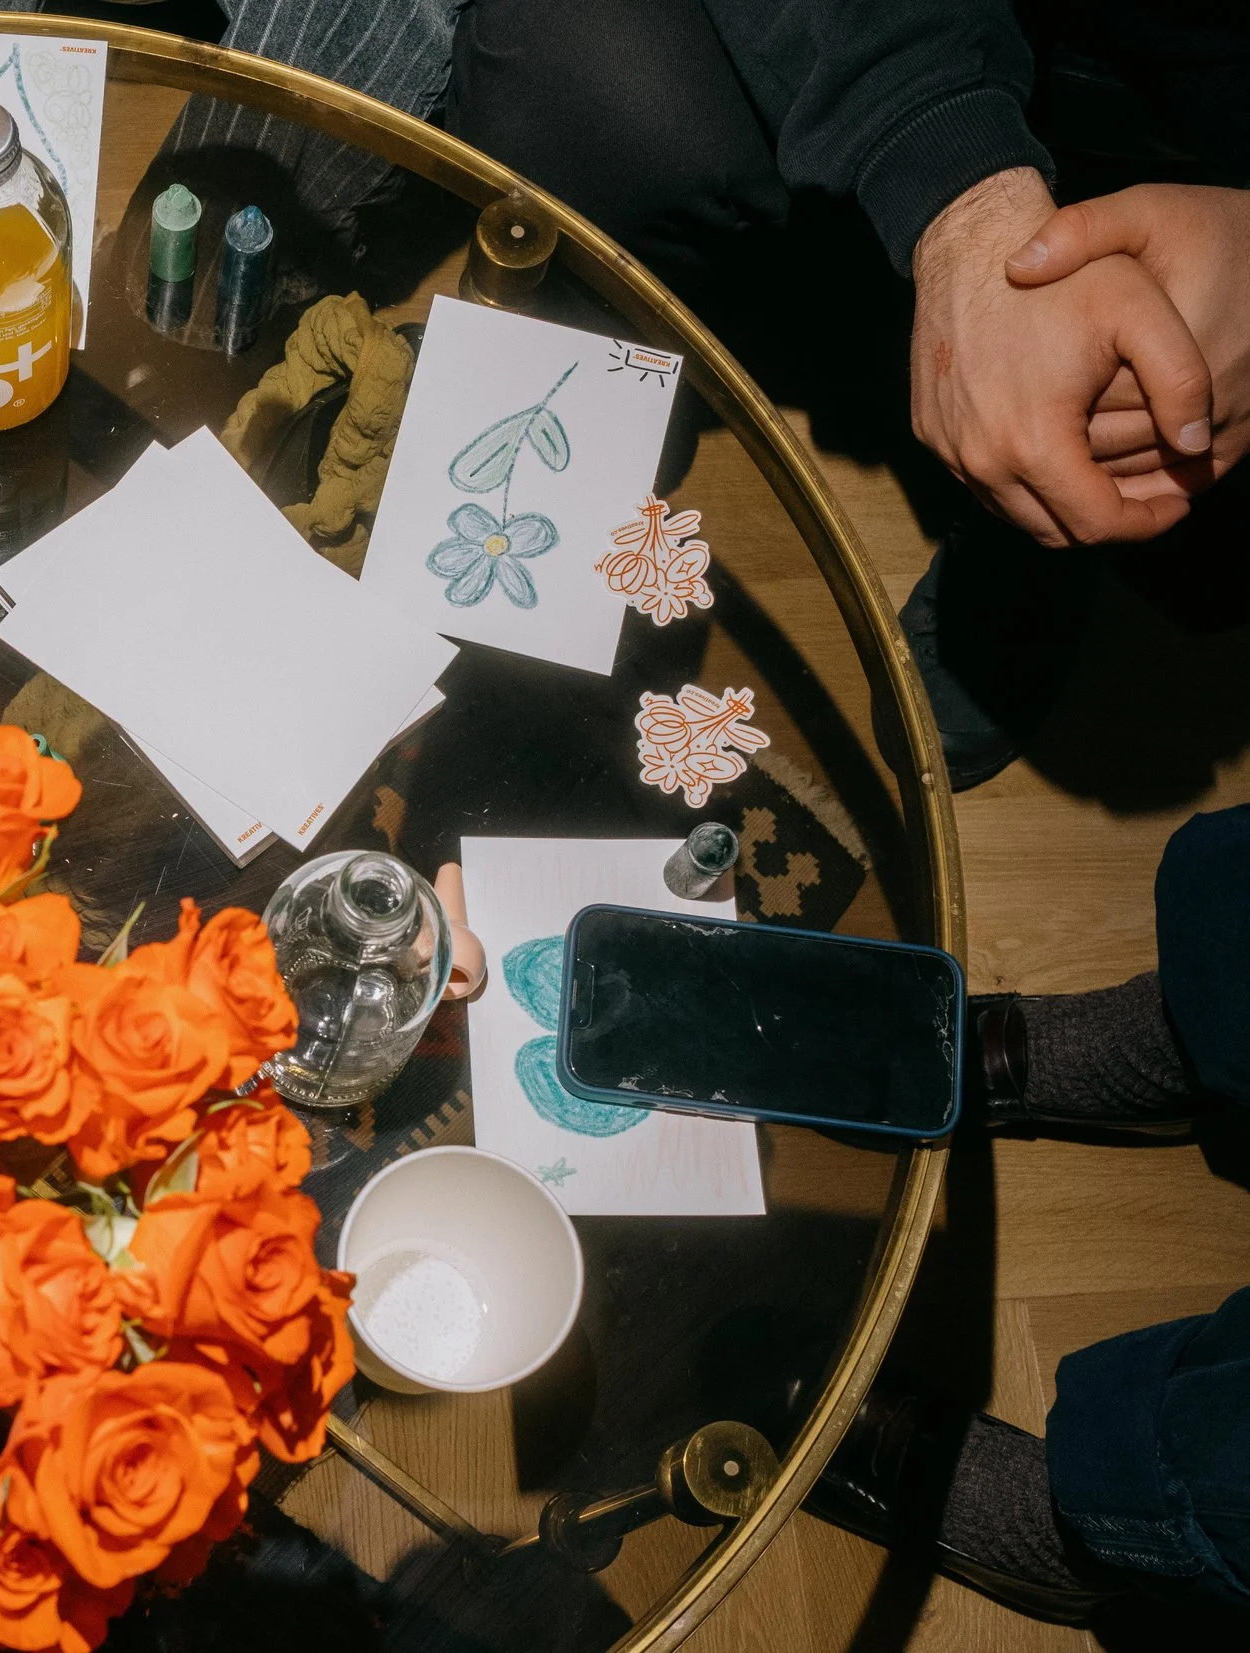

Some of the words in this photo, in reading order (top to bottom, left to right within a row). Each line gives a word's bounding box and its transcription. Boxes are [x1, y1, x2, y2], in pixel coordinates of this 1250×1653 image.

[62, 46, 97, 54] KREATIVES
[634, 353, 671, 368] KREATIVES
[610, 520, 645, 537] kreatives.co
[297, 803, 324, 836] KREATIVES
[237, 821, 263, 844] KREATIV
